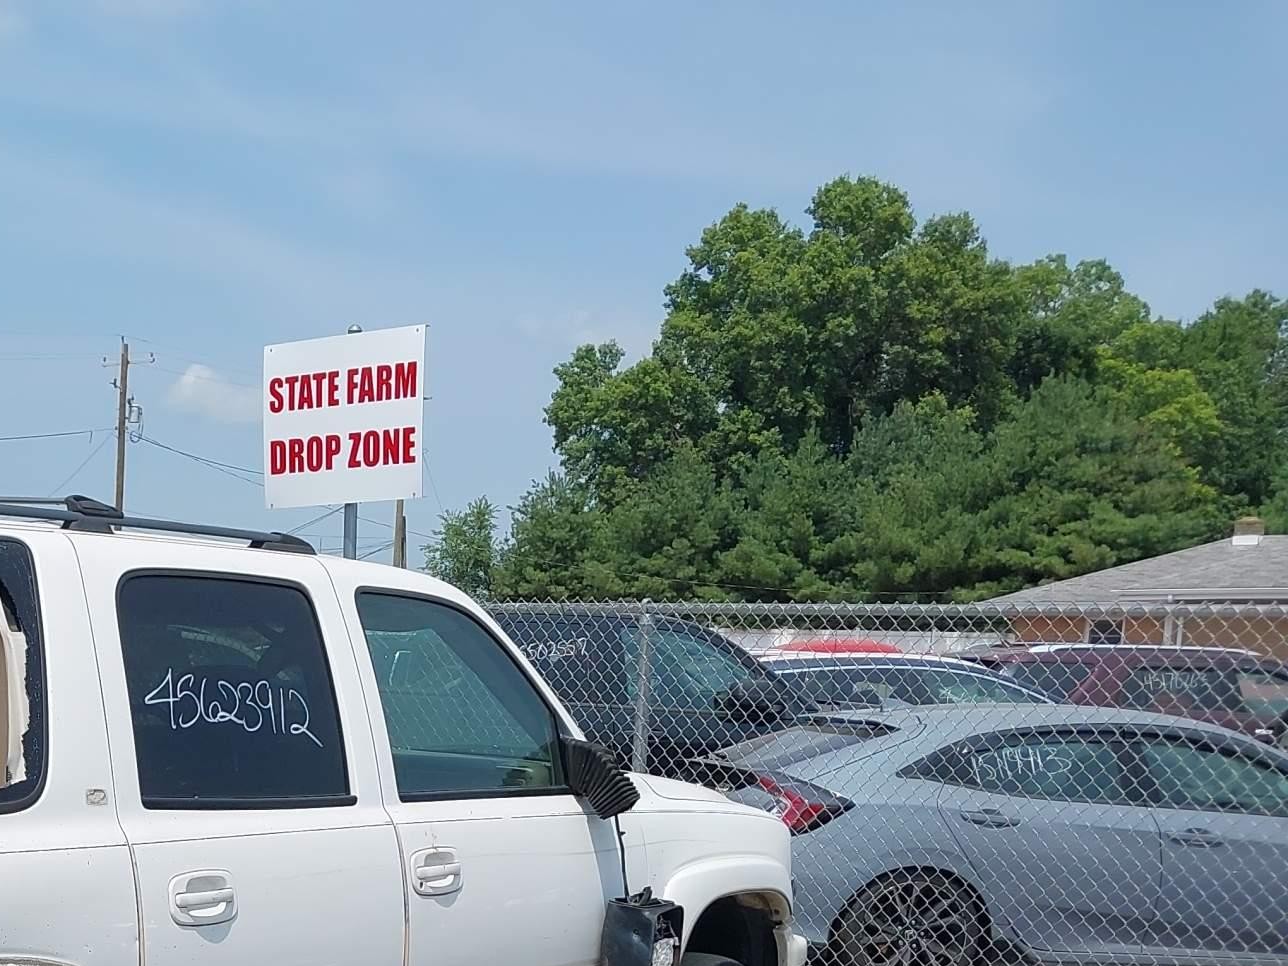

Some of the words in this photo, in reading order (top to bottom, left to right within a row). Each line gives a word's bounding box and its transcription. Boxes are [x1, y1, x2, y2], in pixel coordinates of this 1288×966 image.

[269, 371, 339, 414] STATE
[347, 361, 417, 404] FARM
[270, 435, 341, 475] DROP
[348, 427, 415, 468] ZONE
[145, 668, 323, 747] 45623912
